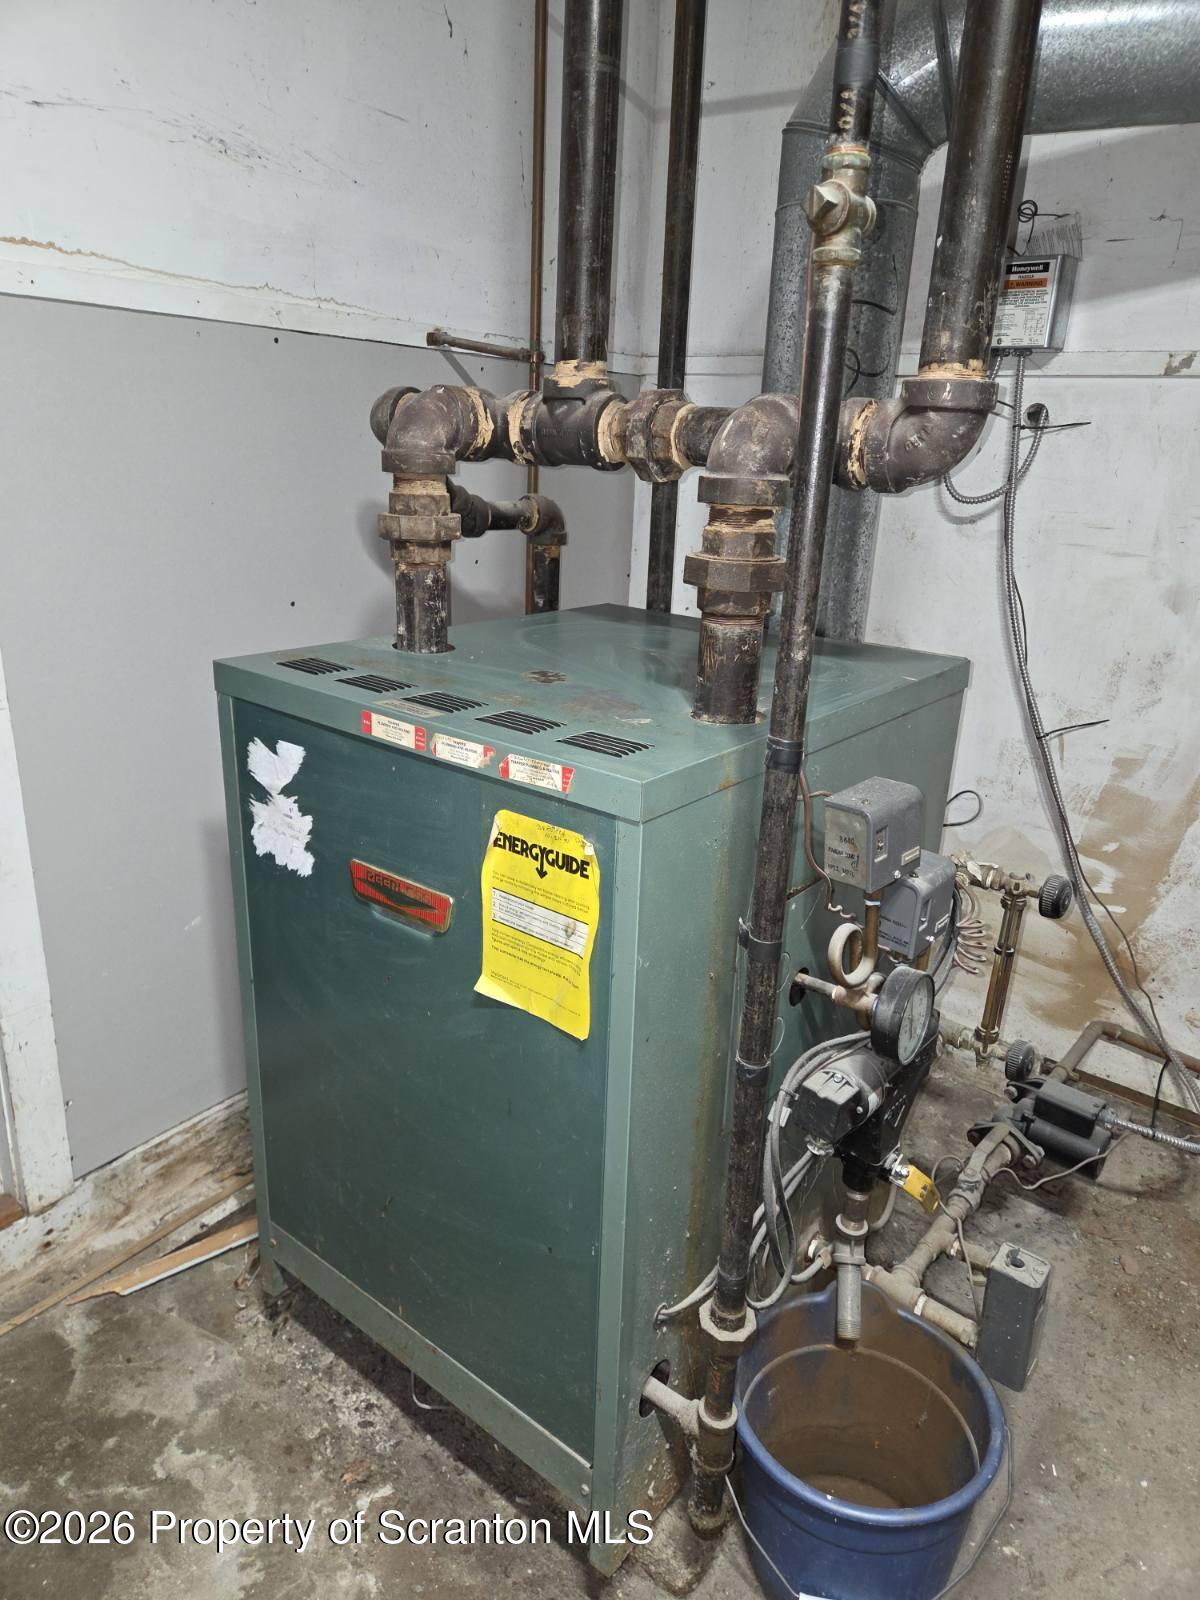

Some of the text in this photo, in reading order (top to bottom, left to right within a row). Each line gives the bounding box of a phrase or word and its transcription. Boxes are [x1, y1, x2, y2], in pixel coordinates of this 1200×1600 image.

[1011, 264, 1044, 273] Honeywell
[493, 832, 590, 879] ENERGYGUIDE
[366, 869, 432, 906] PEER
